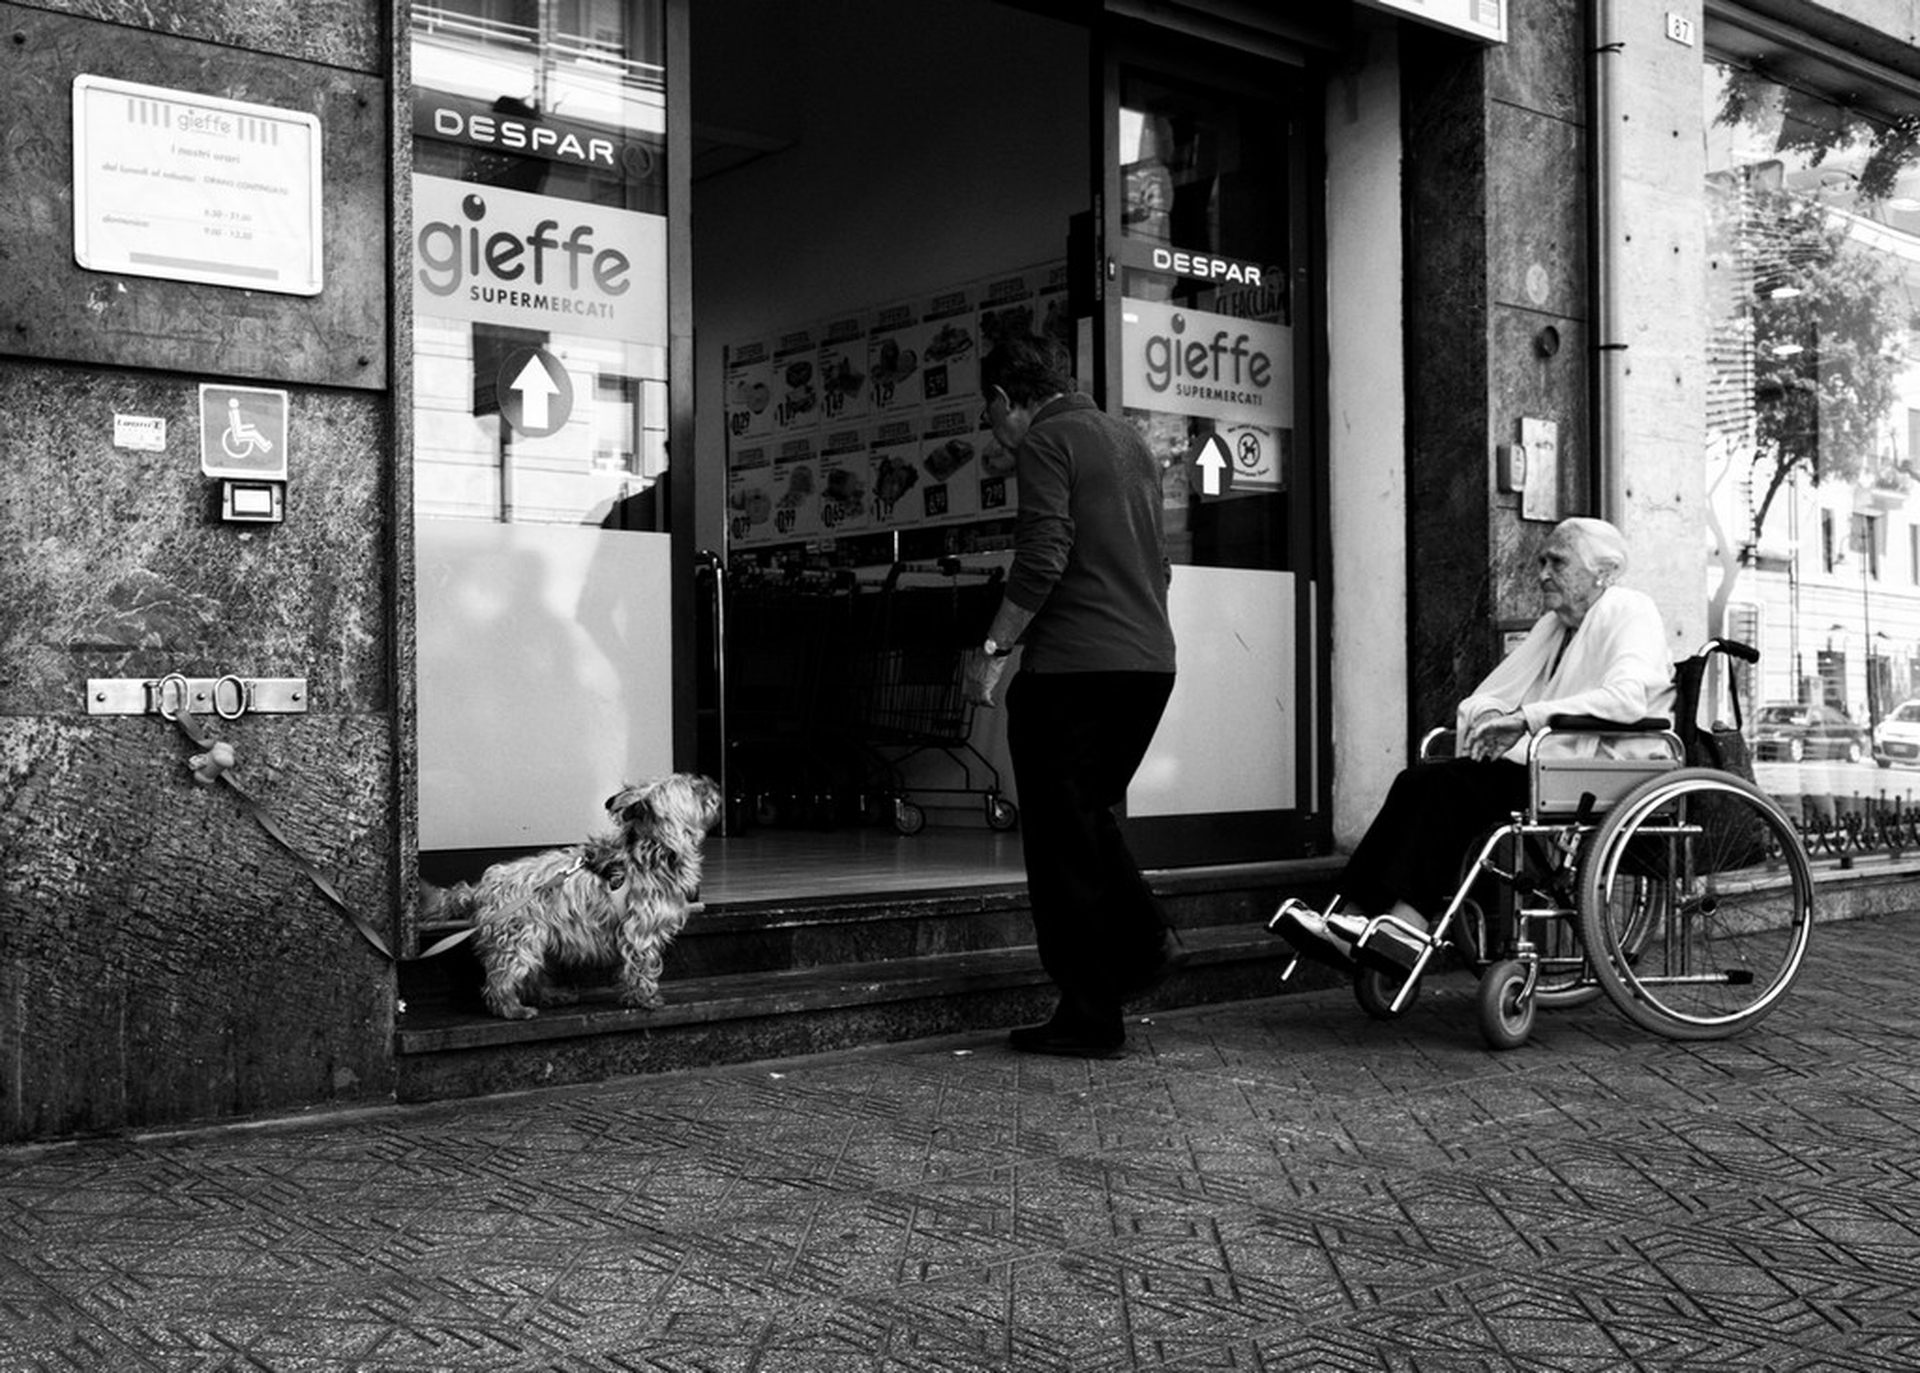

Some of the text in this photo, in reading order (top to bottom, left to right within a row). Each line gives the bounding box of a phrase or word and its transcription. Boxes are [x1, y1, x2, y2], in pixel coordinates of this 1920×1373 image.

[177, 108, 231, 134] gieffe
[434, 107, 615, 166] DESPAR
[418, 194, 630, 296] gieffe
[1153, 249, 1261, 286] DESPAR
[470, 286, 614, 319] SUPERMERCATI
[1146, 313, 1271, 393] gieffe
[1176, 384, 1262, 405] SUPERMERCATI
